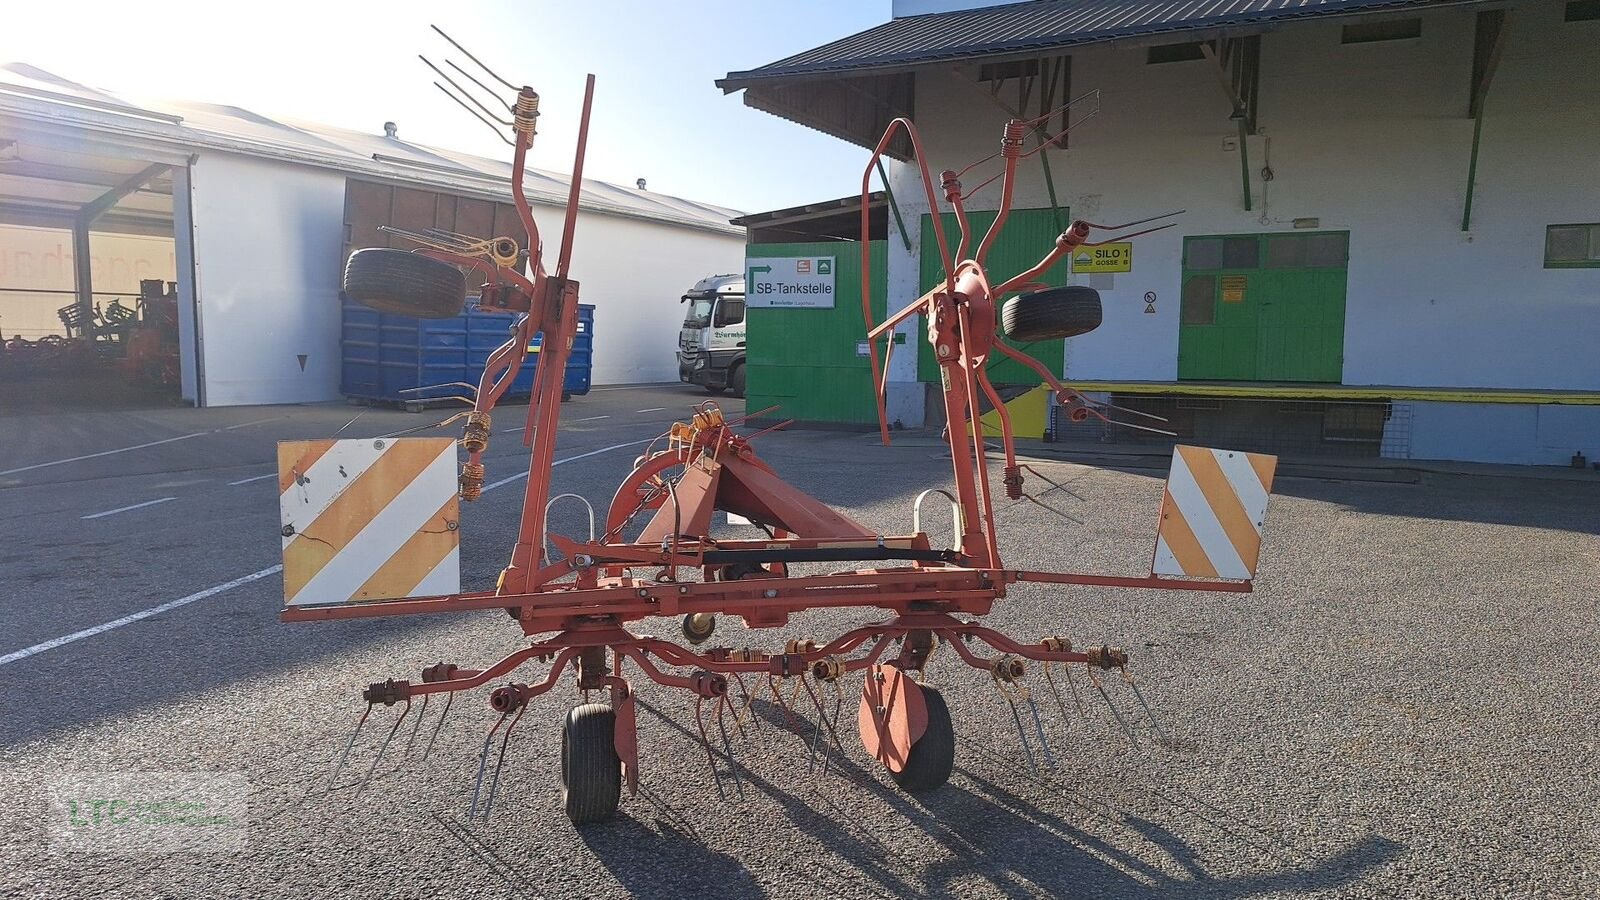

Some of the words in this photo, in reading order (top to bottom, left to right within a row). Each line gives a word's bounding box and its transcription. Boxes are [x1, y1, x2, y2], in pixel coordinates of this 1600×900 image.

[1095, 249, 1120, 258] SILO
[1123, 249, 1129, 258] 1
[756, 282, 832, 294] SB-Tankstelle
